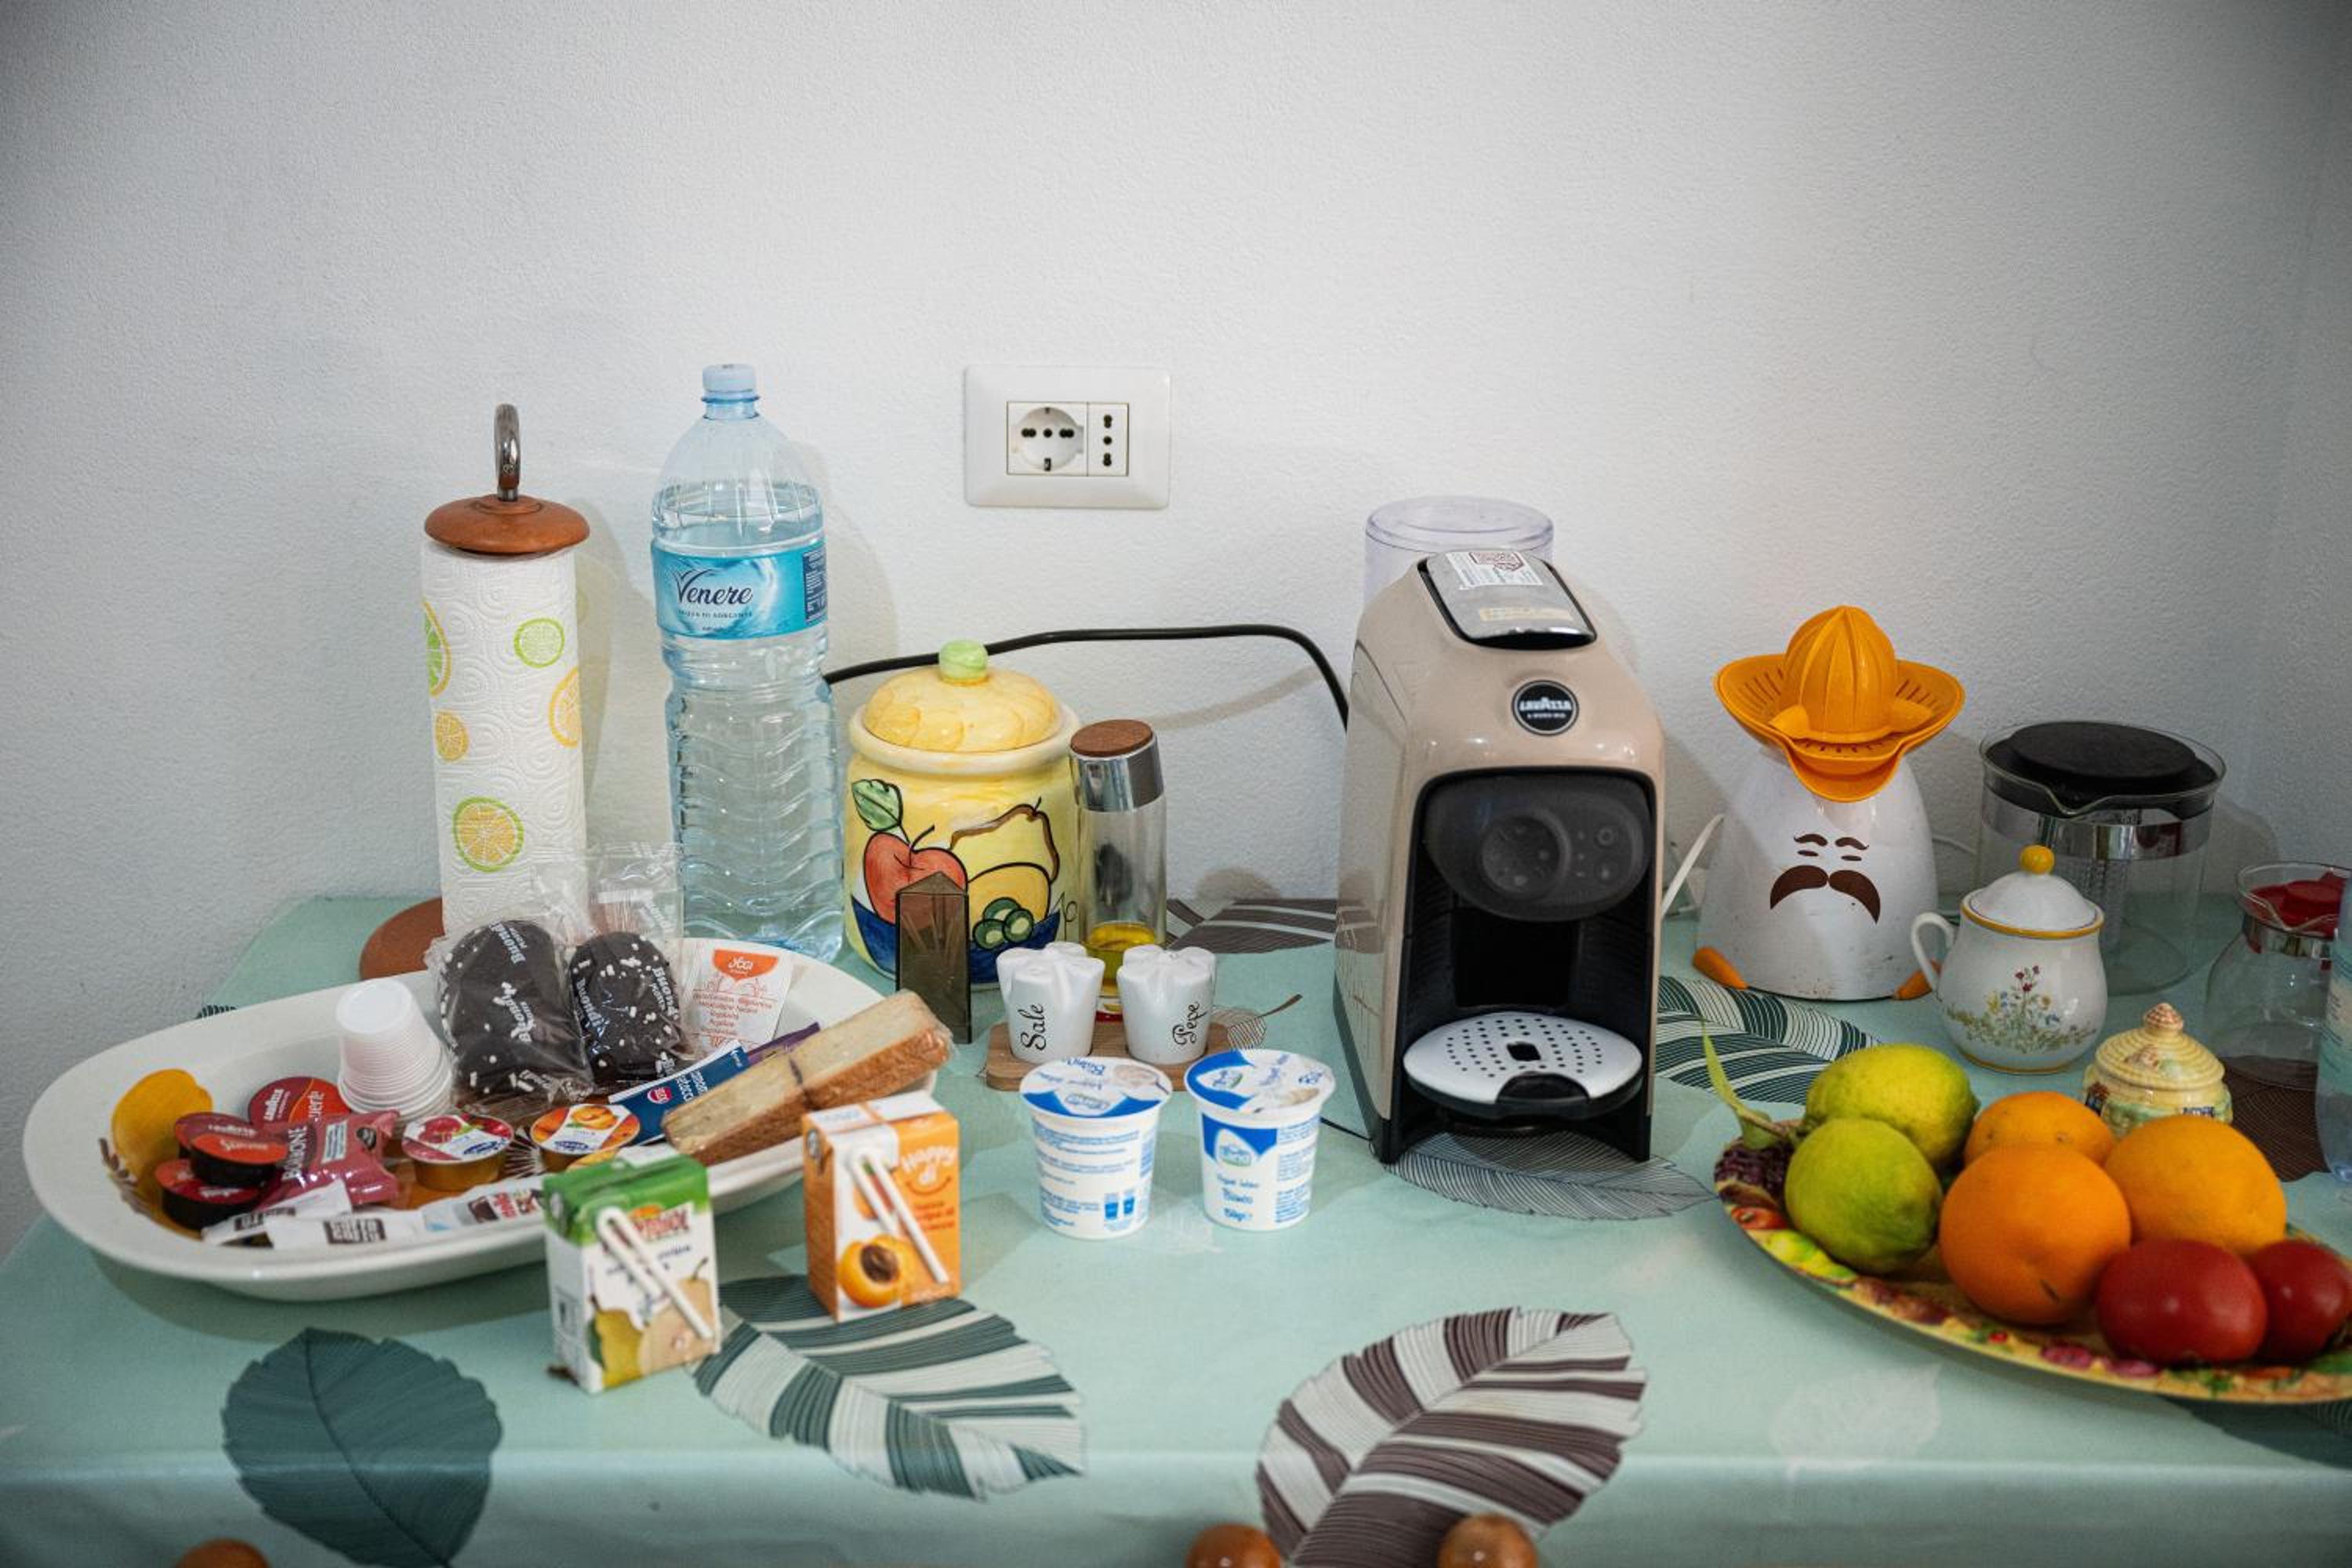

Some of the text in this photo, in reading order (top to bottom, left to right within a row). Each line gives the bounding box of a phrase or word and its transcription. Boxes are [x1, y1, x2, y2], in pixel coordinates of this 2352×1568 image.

[673, 569, 753, 605] Venere
[1018, 1003, 1047, 1051] Sale
[1172, 1001, 1208, 1045] Pepe
[307, 1091, 325, 1121] uerte
